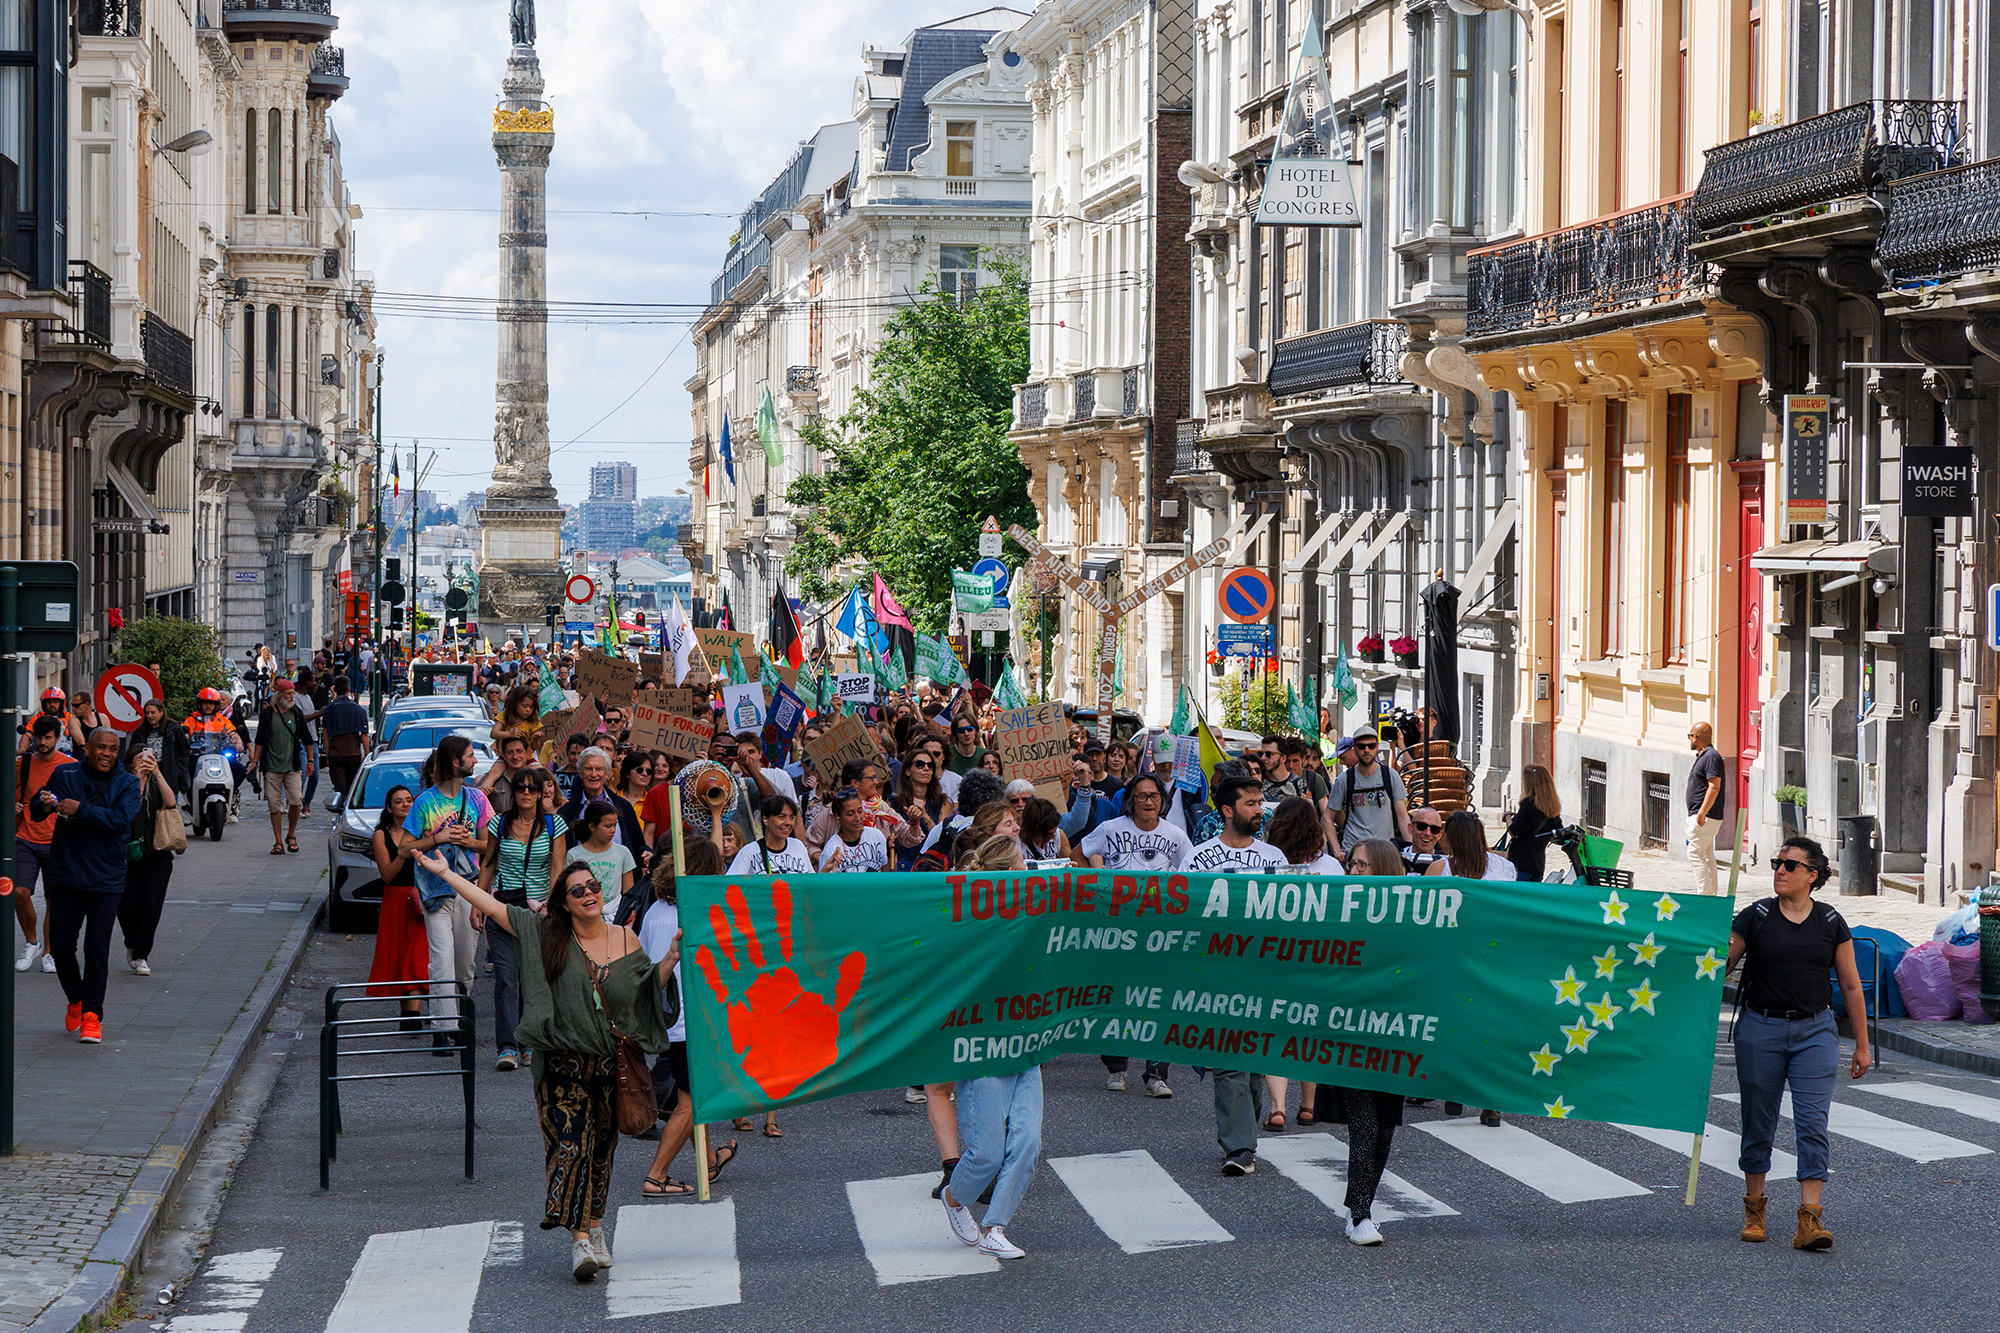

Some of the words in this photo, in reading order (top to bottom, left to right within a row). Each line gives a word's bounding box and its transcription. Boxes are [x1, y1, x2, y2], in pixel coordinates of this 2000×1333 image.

[1280, 168, 1341, 183] HOTEL
[1296, 185, 1323, 199] DU
[1263, 200, 1354, 216] CONGRES
[1907, 465, 1967, 481] iWASH
[1914, 485, 1957, 498] STORE
[1010, 523, 1046, 557] WEES
[1044, 555, 1078, 584] NIET
[1118, 591, 1142, 614] DAT
[1140, 574, 1169, 599] WEET
[1169, 562, 1192, 582] ELK
[1192, 538, 1230, 567] KIND
[704, 632, 744, 649] WALK
[1101, 624, 1117, 664] GEBRUIK
[655, 690, 675, 699] FUCK
[839, 685, 870, 695] ECOCIDE
[840, 676, 870, 689] STOP
[1099, 673, 1114, 703] ZON
[669, 705, 692, 713] PLANET
[1099, 704, 1109, 712] &
[1380, 701, 1390, 714] P
[637, 706, 654, 721] DO
[657, 713, 671, 724] IT
[673, 716, 694, 733] FOR
[694, 724, 714, 739] OUR
[655, 727, 709, 757] FUTURE
[811, 734, 838, 757] NO
[832, 720, 859, 741] TO
[1003, 725, 1053, 748] STOP
[821, 733, 874, 779] PUTIN'S
[1004, 738, 1071, 765] SUBSIDIZING
[1008, 756, 1074, 780] FOSSILS
[946, 873, 1099, 923] TOUCHE
[1108, 873, 1190, 917] PAS
[1201, 878, 1230, 918] A
[1244, 879, 1329, 922] MON
[1340, 884, 1464, 928] FUTUR
[1046, 925, 1139, 954] HANDS
[1145, 930, 1201, 952] OFF
[1207, 932, 1254, 957] MY
[1258, 935, 1366, 966] FUTURE
[940, 1003, 984, 1031] ALL
[994, 984, 1115, 1023] TOGETHER
[1125, 986, 1163, 1009] WE
[1171, 989, 1262, 1018] MARCH
[1269, 999, 1319, 1026] FOR
[1327, 1006, 1439, 1042] CLIMATE
[953, 1017, 1098, 1063] DEMOCRACY
[1102, 1018, 1158, 1043] AND
[1164, 1024, 1276, 1057] AGAINST
[1280, 1035, 1428, 1080] AUSTERITY.
